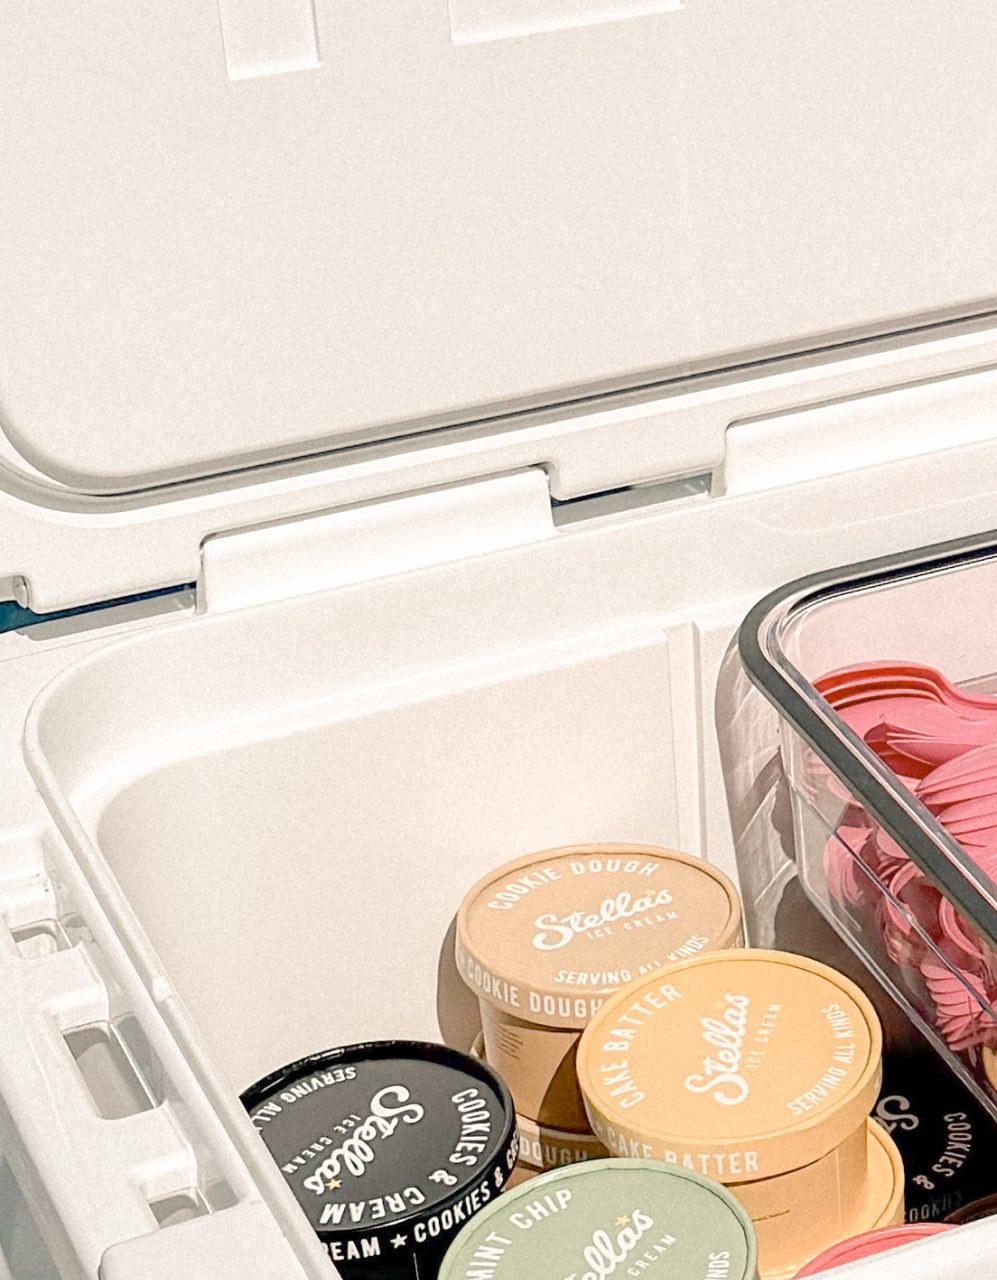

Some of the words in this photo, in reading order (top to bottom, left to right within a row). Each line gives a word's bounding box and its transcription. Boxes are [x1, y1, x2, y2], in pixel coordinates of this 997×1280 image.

[487, 867, 562, 910] COOKIE
[570, 859, 660, 876] DOUGH
[586, 926, 615, 941] ICE
[623, 911, 679, 931] CREAM
[468, 959, 520, 1008] COOKIE
[529, 991, 605, 1019] DOUGH
[554, 969, 632, 986] SERVING
[602, 982, 682, 1052] BATTER
[755, 1003, 783, 1044] CREAM
[820, 1003, 855, 1039] KINDS
[832, 1042, 856, 1065] ALL
[280, 1066, 357, 1103] SERVING
[600, 1059, 646, 1110] CAKE
[333, 1114, 361, 1135] ICE
[449, 1088, 491, 1167] COOKIES
[281, 1136, 333, 1174] CREAM
[931, 1112, 973, 1178] COOKIES
[429, 1169, 458, 1186] &
[912, 1174, 935, 1190] &
[319, 1186, 426, 1225] CREAM
[413, 1181, 491, 1243] COOKIES
[509, 1188, 573, 1230] CHIP
[626, 1233, 678, 1277] CREAM
